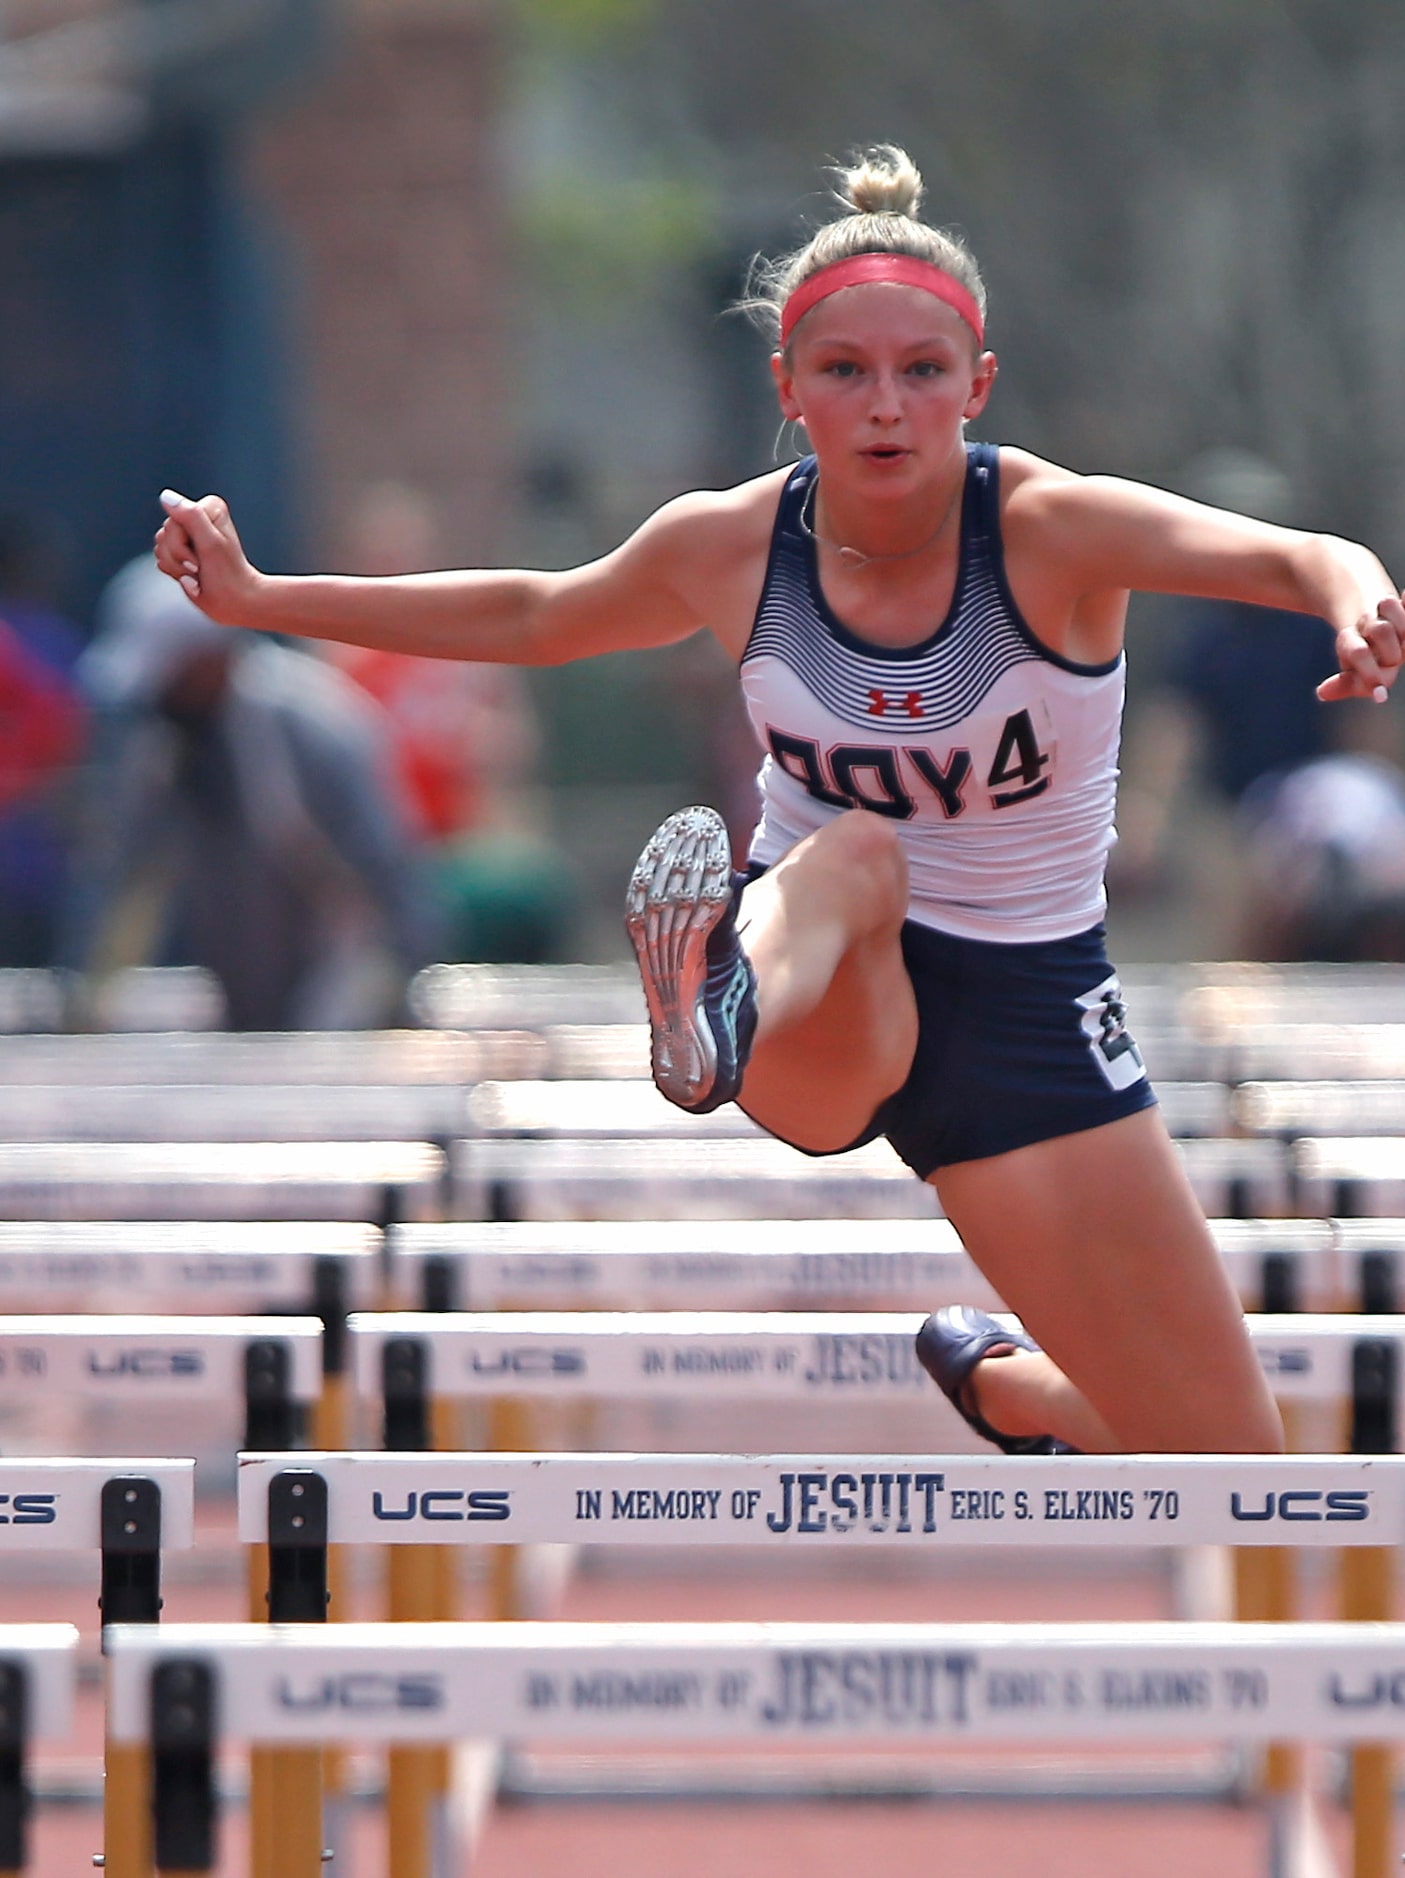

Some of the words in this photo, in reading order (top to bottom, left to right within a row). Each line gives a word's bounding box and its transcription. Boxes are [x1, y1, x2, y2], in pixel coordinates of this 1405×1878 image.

[987, 708, 1049, 787] 4
[804, 1333, 920, 1384] JESU
[372, 1491, 511, 1521] UCS
[576, 1490, 602, 1520] IN
[611, 1490, 722, 1520] MEMORY
[731, 1490, 761, 1520] OF
[766, 1473, 945, 1534] JESUIT
[950, 1490, 1005, 1520] ERIC
[1014, 1490, 1034, 1520] S.
[1043, 1490, 1134, 1520] ELKINS
[1143, 1489, 1179, 1520] '70
[1230, 1491, 1369, 1522] UCS
[762, 1651, 977, 1727] JESUIT
